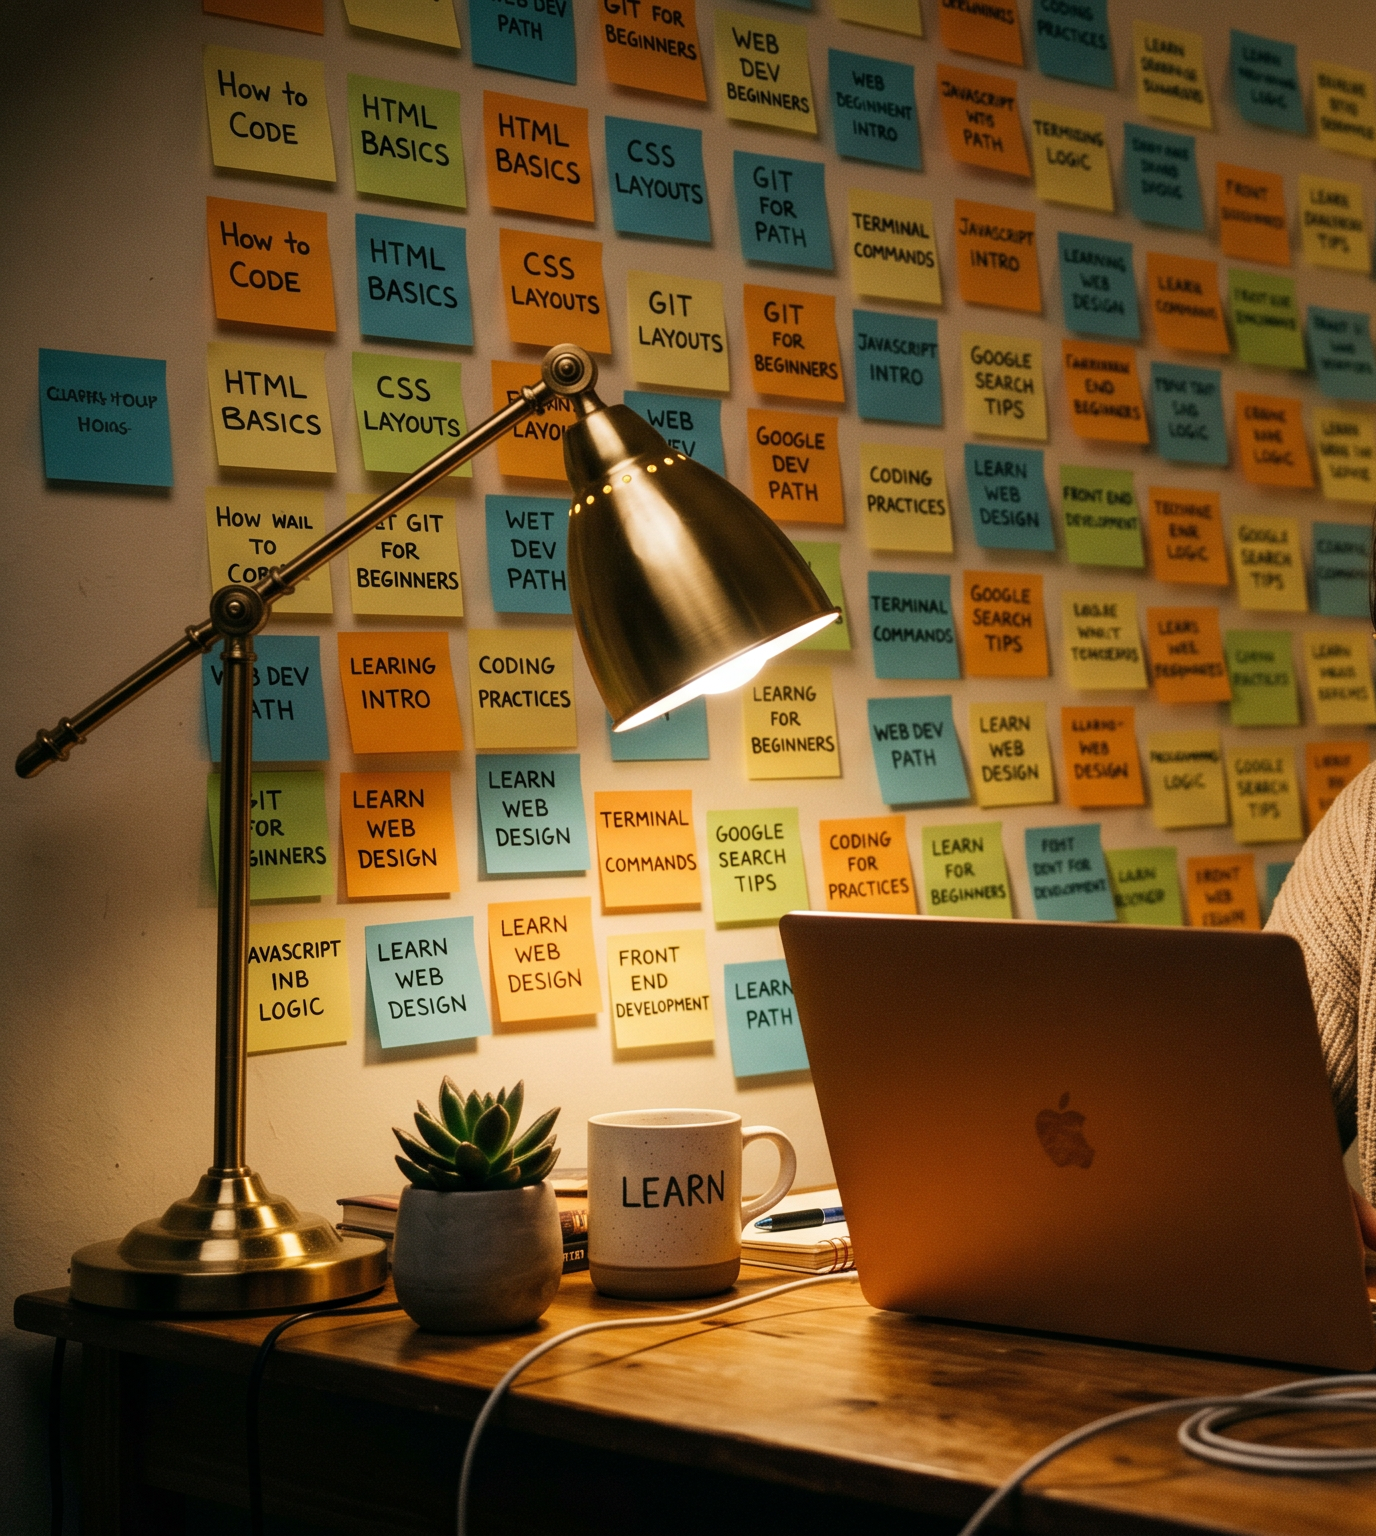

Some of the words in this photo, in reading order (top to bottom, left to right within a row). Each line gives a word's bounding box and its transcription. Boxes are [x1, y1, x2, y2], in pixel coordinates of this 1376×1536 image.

[604, 0, 641, 18] GIT
[652, 5, 684, 28] FOR
[497, 14, 542, 41] PATH
[605, 24, 697, 60] BEGINNERS
[732, 27, 779, 54] WEB
[739, 58, 780, 82] DEV
[217, 69, 270, 102] How
[283, 81, 308, 107] to
[852, 71, 885, 91] WEB
[727, 82, 810, 114] BEGINNERS
[363, 94, 437, 129] HTML
[498, 113, 570, 148] HTML
[852, 120, 898, 142] INTRO
[963, 129, 1004, 152] PATH
[361, 130, 449, 166] BASICS
[627, 140, 675, 168] CSS
[496, 147, 581, 185] BASICS
[1047, 148, 1091, 171] LOGIC
[615, 172, 703, 204] LAYOUTS
[753, 166, 793, 192] GIT
[759, 197, 797, 219] FOR
[754, 221, 807, 248] PATH
[853, 213, 929, 238] TERMINAL
[959, 218, 1034, 246] JAVASCRIPT
[220, 220, 272, 252] How
[284, 231, 310, 256] to
[370, 237, 446, 272] HTML
[854, 242, 935, 268] COMMANDS
[970, 250, 1020, 272] INTRO
[523, 252, 575, 280] CSS
[367, 275, 458, 309] BASICS
[1080, 273, 1110, 291] WEB
[511, 285, 600, 315] LAYOUTS
[649, 291, 692, 317] GIT
[1073, 293, 1125, 315] DESIGN
[763, 301, 804, 325] GIT
[638, 326, 723, 353] LAYOUTS
[772, 331, 805, 349] FOR
[858, 333, 938, 358] JAVASCRIPT
[754, 354, 839, 380] BEGINNERS
[970, 346, 1032, 369] GOOGLE
[224, 369, 307, 399] HTML
[870, 364, 924, 386] INTRO
[975, 372, 1034, 394] SEARCH
[377, 375, 431, 402] CSS
[984, 397, 1025, 420] TIPS
[221, 406, 322, 435] BASICS
[363, 410, 461, 437] LAYOUTS
[513, 420, 565, 441] LAYO
[647, 409, 694, 431] WEB
[756, 426, 825, 450] GOOGLE
[772, 455, 810, 473] DEV
[974, 459, 1027, 479] LEARN
[870, 465, 933, 486] CODING
[768, 481, 818, 501] PATH
[984, 485, 1021, 503] WEB
[1063, 486, 1103, 503] FRONT
[1106, 489, 1133, 506] END
[867, 495, 946, 516] PRACTICES
[272, 513, 313, 529] WAIL
[406, 514, 443, 532] GIT
[505, 510, 554, 530] WET
[980, 508, 1040, 528] DESIGN
[1065, 512, 1137, 531] DEVELOPMENT
[1238, 526, 1289, 544] GOOGLE
[249, 538, 277, 555] TO
[381, 542, 420, 560] FOR
[511, 539, 556, 560] DEV
[1241, 548, 1293, 568] SEARCH
[357, 568, 459, 590] BEGINNERS
[507, 568, 566, 591] PATH
[1252, 572, 1285, 591] TIPS
[971, 584, 1031, 604] GOOGLE
[870, 595, 948, 615] TERMINAL
[973, 609, 1032, 628] SEARCH
[873, 625, 953, 644] COMMANDS
[985, 635, 1022, 653] TIPS
[351, 657, 436, 676] LEARING
[479, 655, 555, 675] CODING
[267, 666, 309, 686] DEV
[362, 689, 431, 710] INTRO
[479, 689, 571, 709] PRACTICES
[753, 686, 817, 702] LEARNG
[252, 699, 294, 720] ATH
[771, 712, 801, 727] FOR
[873, 723, 910, 742] WEB
[913, 722, 944, 740] DEV
[980, 716, 1030, 733] LEARN
[752, 736, 835, 754] BEGINNERS
[989, 740, 1025, 758] WEB
[1079, 741, 1109, 756] WEB
[891, 749, 937, 769] PATH
[1235, 759, 1284, 776] GOOGLE
[488, 770, 556, 789] LEARN
[982, 764, 1039, 783] DESIGN
[1074, 763, 1128, 781] DESIGN
[353, 789, 424, 809] LEARN
[1237, 780, 1289, 797] SEARCH
[502, 798, 549, 818] WEB
[1248, 802, 1280, 819] TIPS
[367, 819, 416, 838] WEB
[600, 809, 689, 829] TERMINAL
[496, 827, 571, 847] DESIGN
[716, 824, 784, 843] GOOGLE
[829, 831, 892, 851] CODING
[250, 846, 327, 867] GINNERS
[932, 837, 984, 856] LEARN
[358, 848, 438, 869] DESIGN
[606, 854, 697, 873] COMMANDS
[719, 848, 787, 868] SEARCH
[848, 856, 879, 872] FOR
[1068, 858, 1092, 874] FOR
[945, 863, 975, 879] FOR
[734, 874, 777, 893] TIPS
[829, 878, 910, 900] PRACTICES
[931, 884, 1007, 905] BEGINNERS
[501, 915, 568, 937] LEARN
[248, 939, 342, 964] AVASCRIPT
[378, 937, 448, 962] LEARN
[514, 943, 560, 964] WEB
[619, 946, 680, 966] FRONT
[271, 969, 310, 991] INB
[395, 967, 444, 989] WEB
[508, 968, 582, 993] DESIGN
[631, 973, 668, 991] END
[736, 980, 795, 1000] LEARN
[259, 997, 325, 1022] LOGIC
[388, 994, 467, 1020] DESIGN
[616, 995, 710, 1018] DEVELOPMENT
[747, 1008, 793, 1029] PATH
[622, 1170, 725, 1209] LEARN
